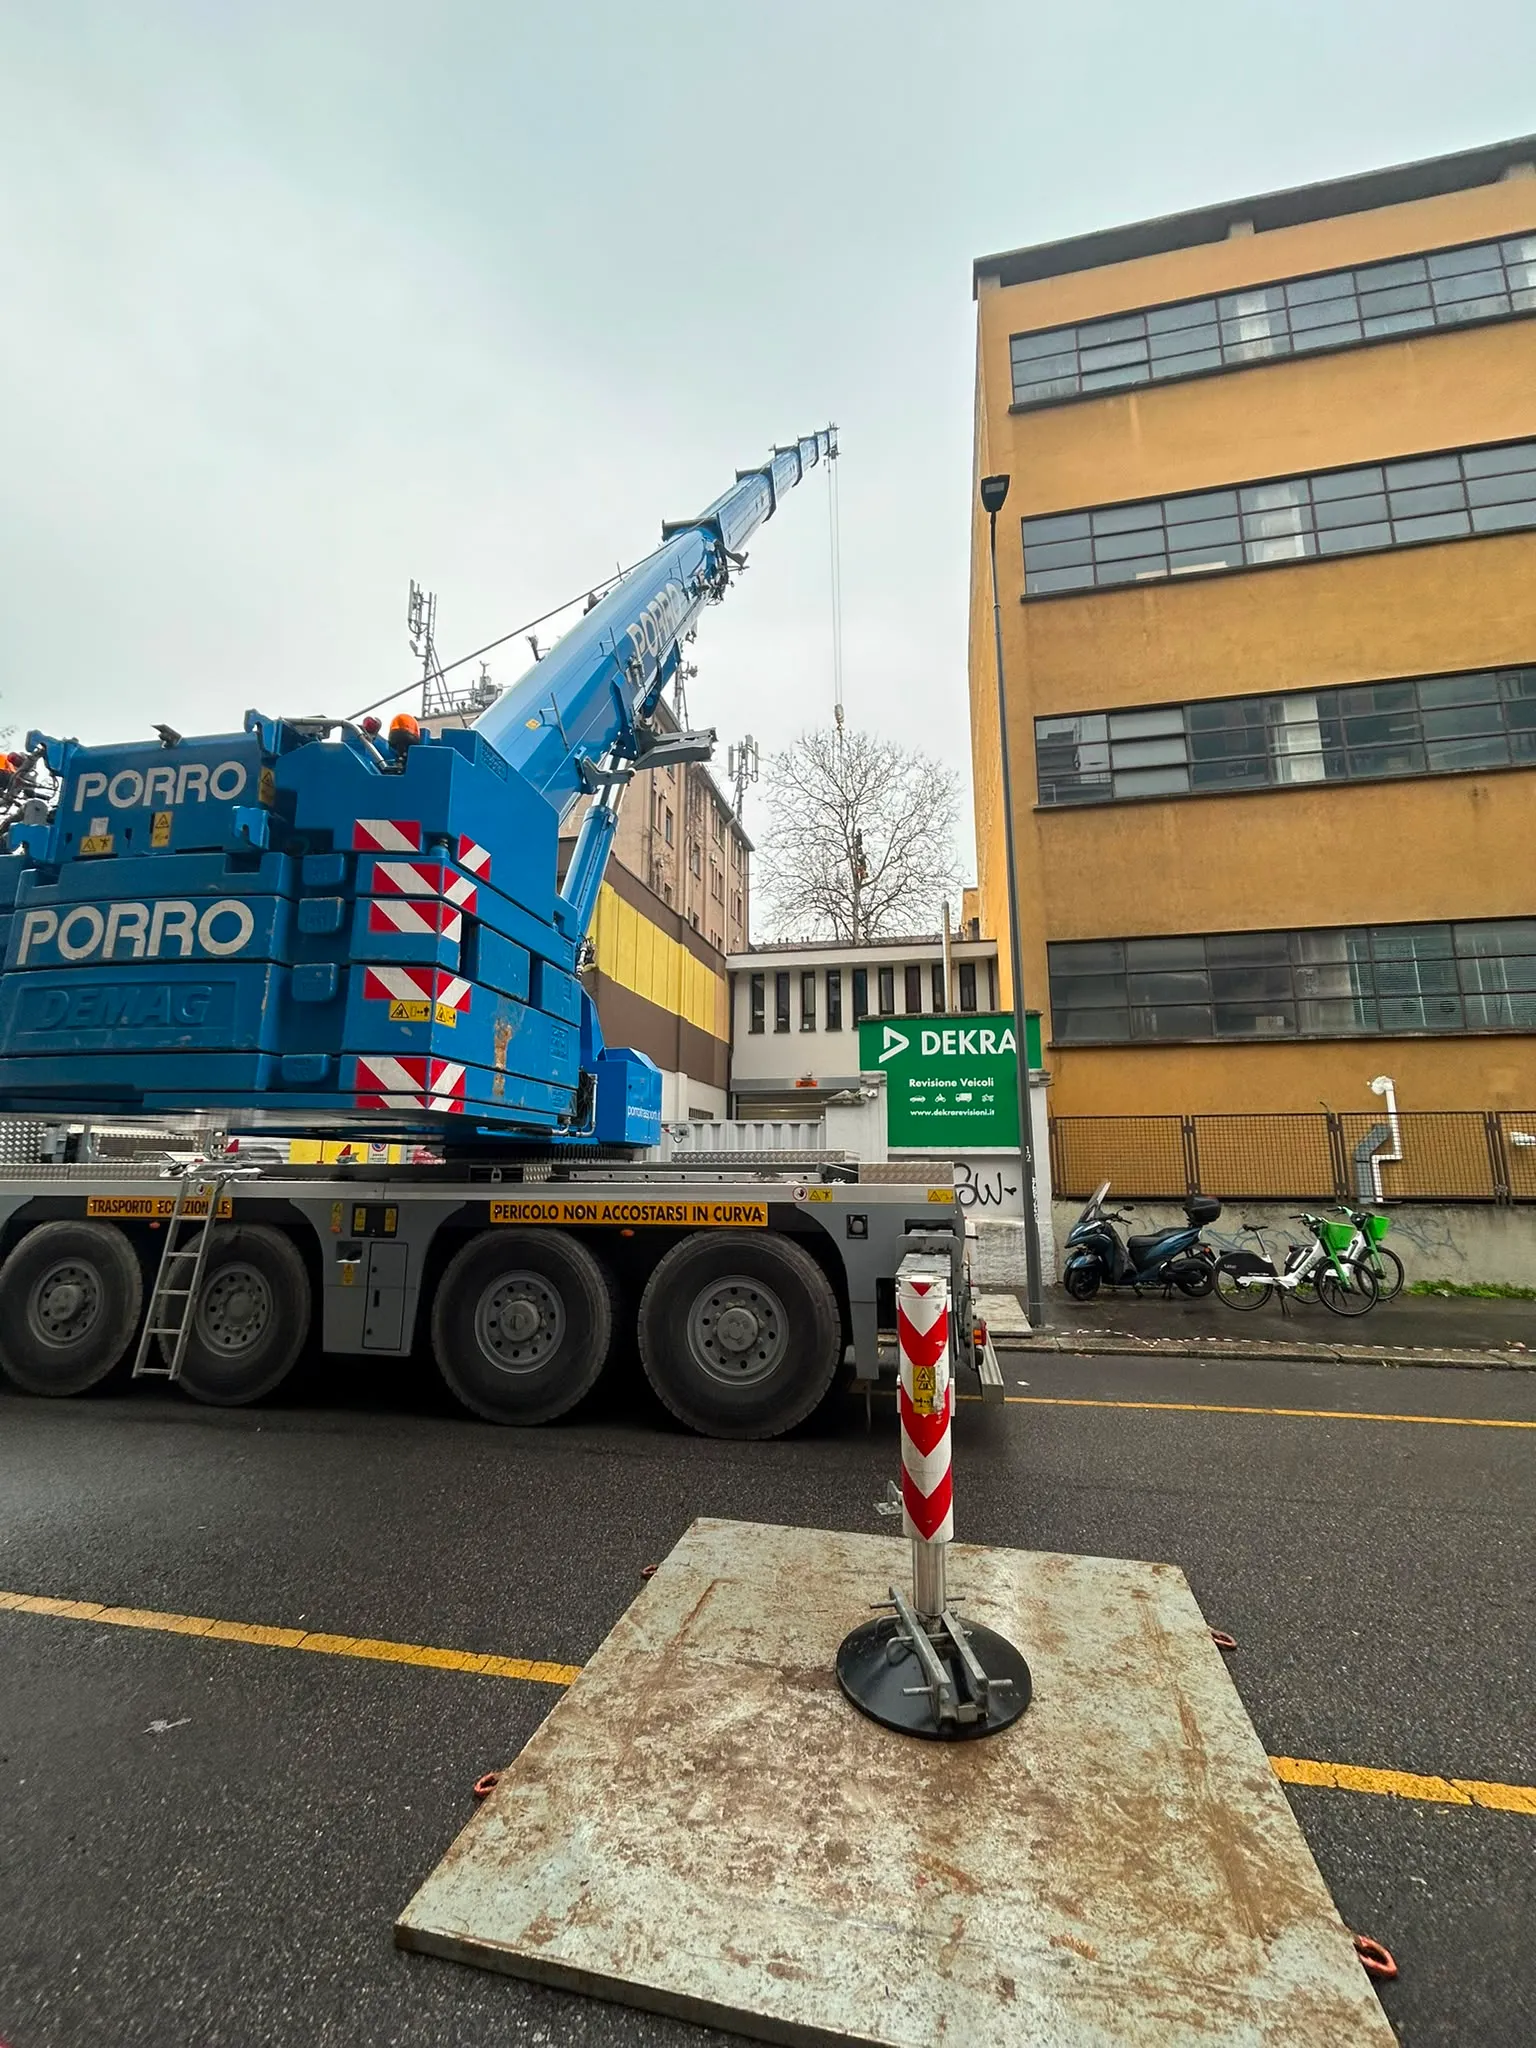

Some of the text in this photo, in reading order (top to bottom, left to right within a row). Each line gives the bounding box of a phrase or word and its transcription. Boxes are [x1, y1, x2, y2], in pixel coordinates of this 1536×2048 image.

[74, 761, 247, 812] PORRO
[16, 900, 254, 966] PORRO
[36, 985, 212, 1029] DEMAG
[921, 1028, 1017, 1055] DEKRA
[909, 1077, 994, 1087] Revisione Veicoli
[92, 1200, 152, 1214] TRASPORTO
[494, 1204, 763, 1222] PERICOLO NON ACCOSTARSI IN CURVA
